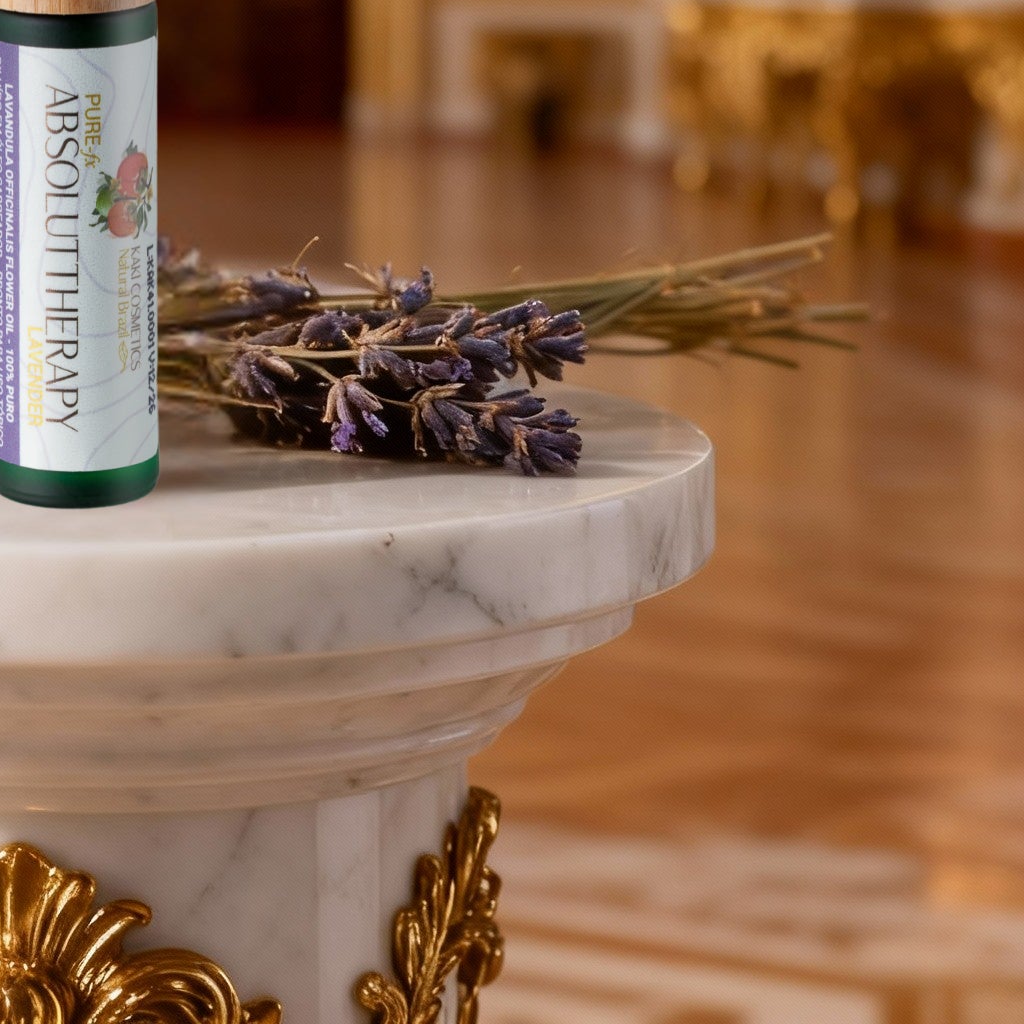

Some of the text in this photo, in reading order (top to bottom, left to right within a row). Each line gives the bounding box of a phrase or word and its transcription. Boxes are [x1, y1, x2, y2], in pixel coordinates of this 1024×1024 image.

[4, 83, 14, 165] LAVANDULA
[5, 169, 15, 253] OFFICINALIS
[5, 256, 15, 310] FLOWER
[45, 84, 80, 432] ABSOLUTTHERAPY
[118, 248, 130, 339] Natural Brazil
[5, 313, 15, 333] OIL
[130, 245, 142, 371] KAKI COSMETICS
[5, 349, 15, 382] 100%
[5, 385, 15, 424] PURO
[27, 325, 44, 427] LAVENDER
